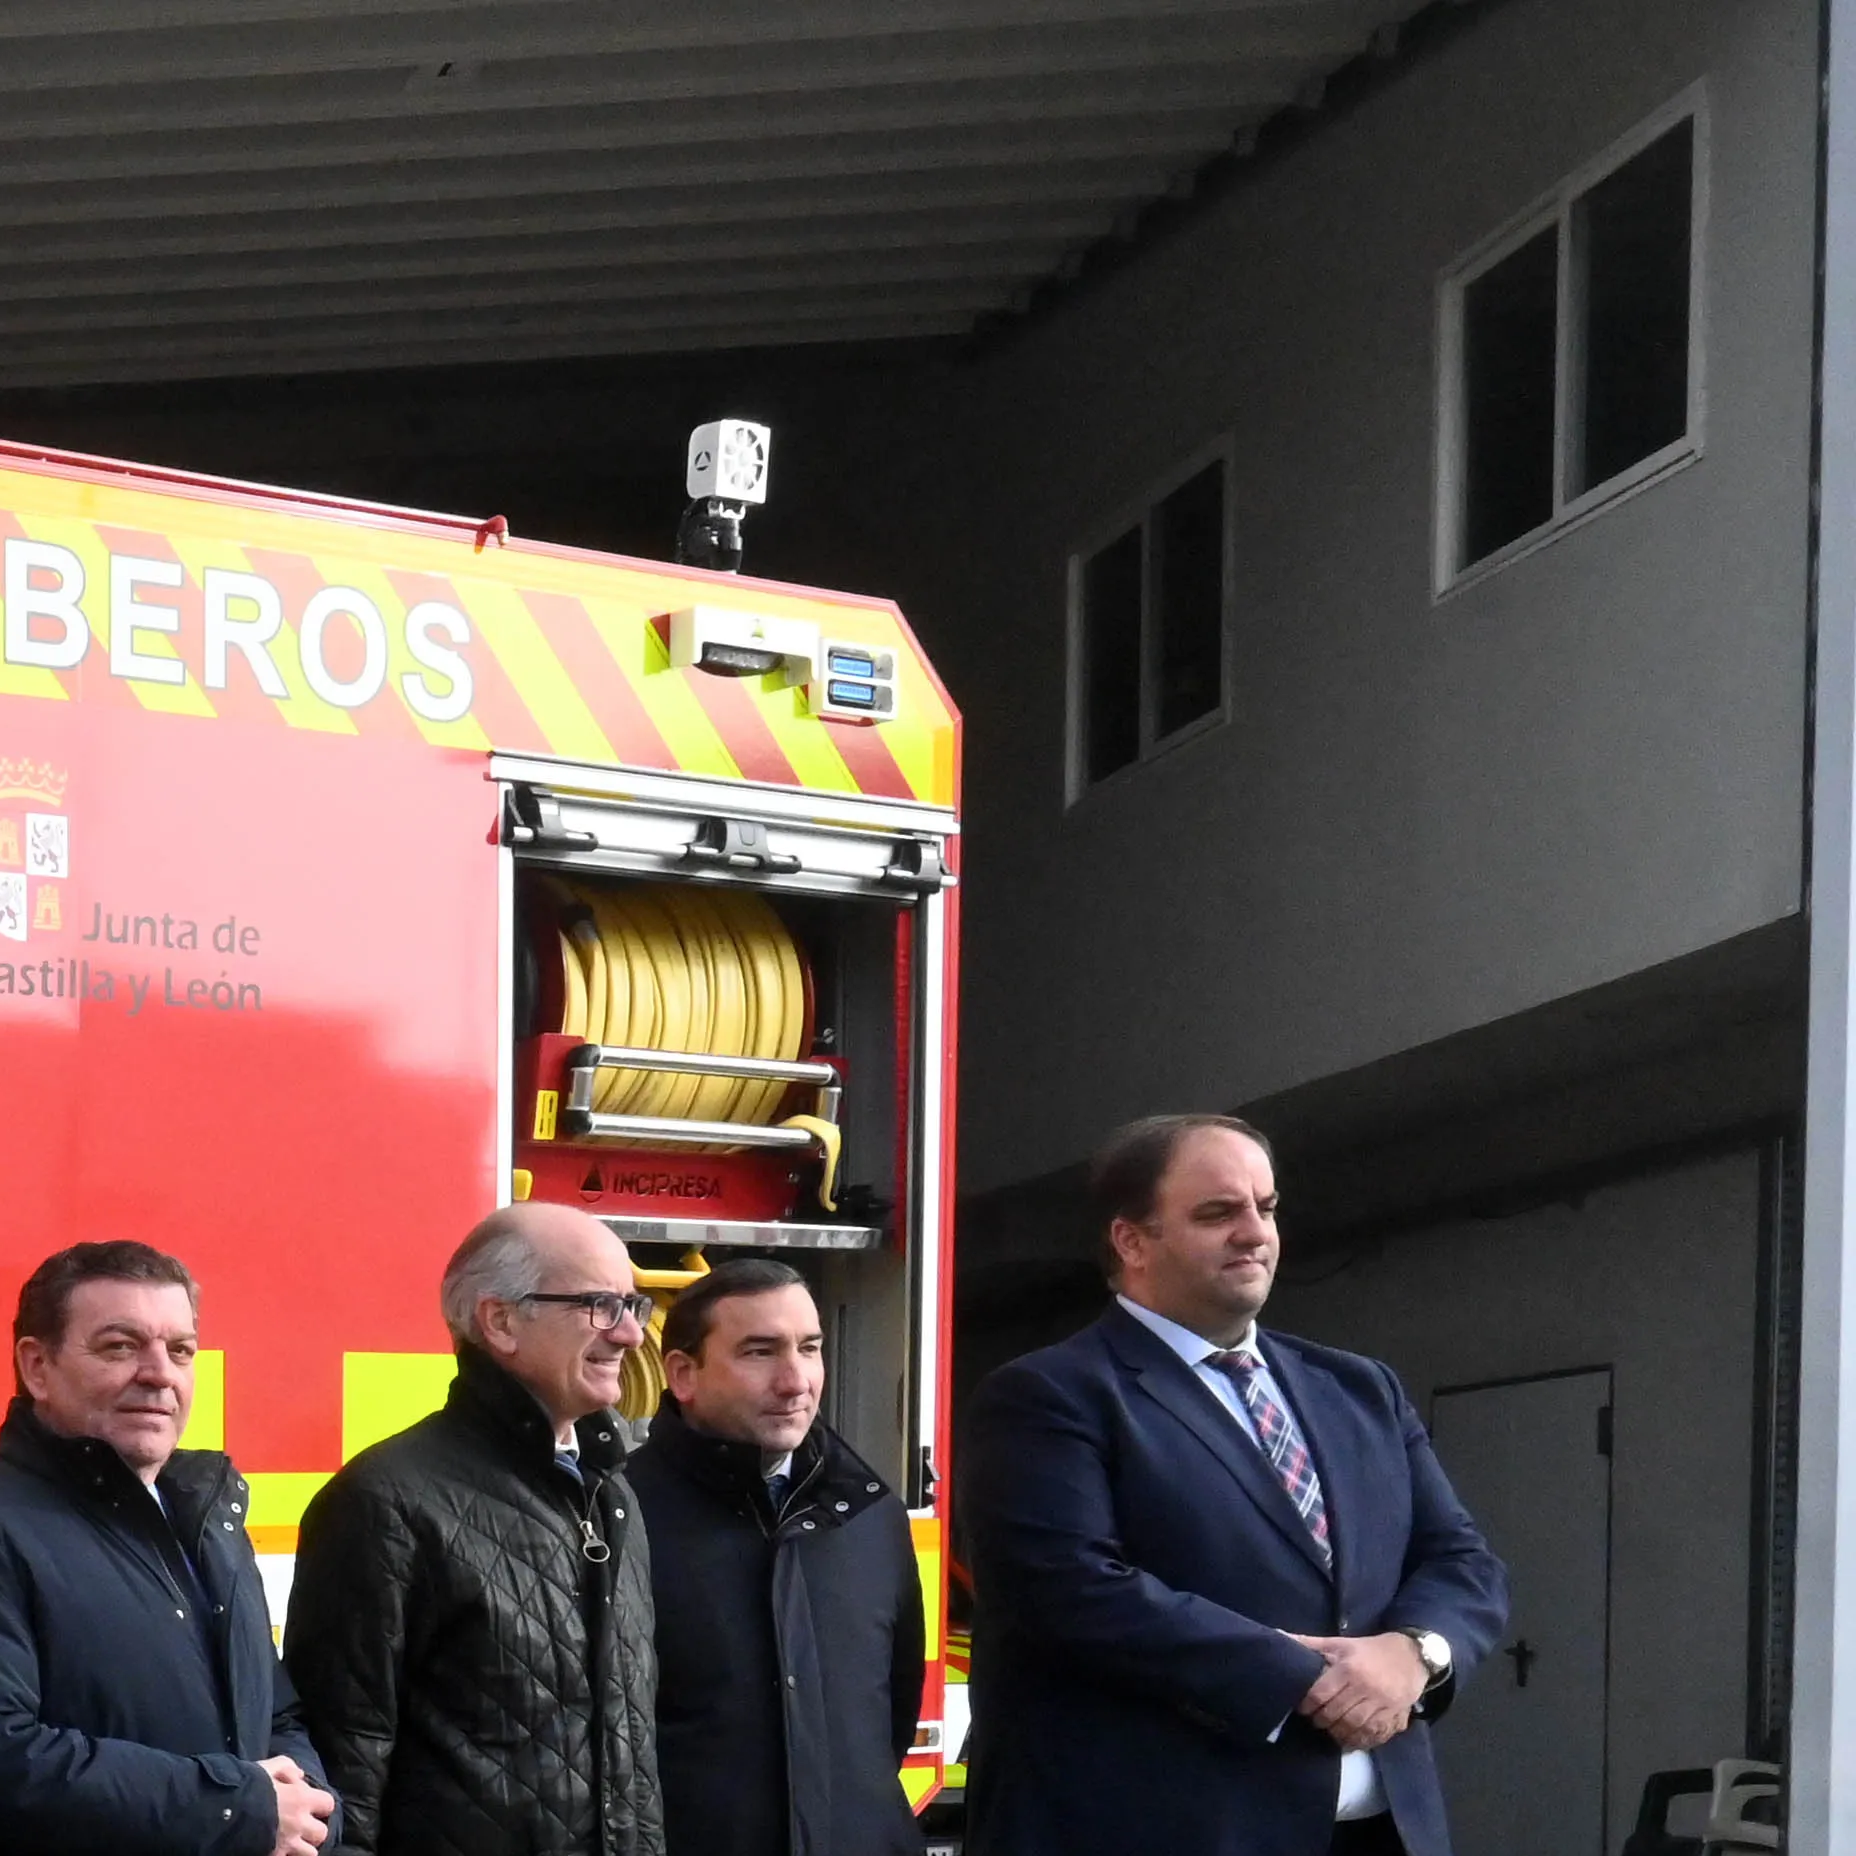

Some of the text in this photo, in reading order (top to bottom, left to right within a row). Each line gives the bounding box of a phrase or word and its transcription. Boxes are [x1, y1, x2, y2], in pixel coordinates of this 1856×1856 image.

[82, 901, 262, 957] Junta de
[126, 973, 151, 1017] y
[164, 966, 264, 1012] León
[612, 1170, 724, 1200] INCIPRESA
